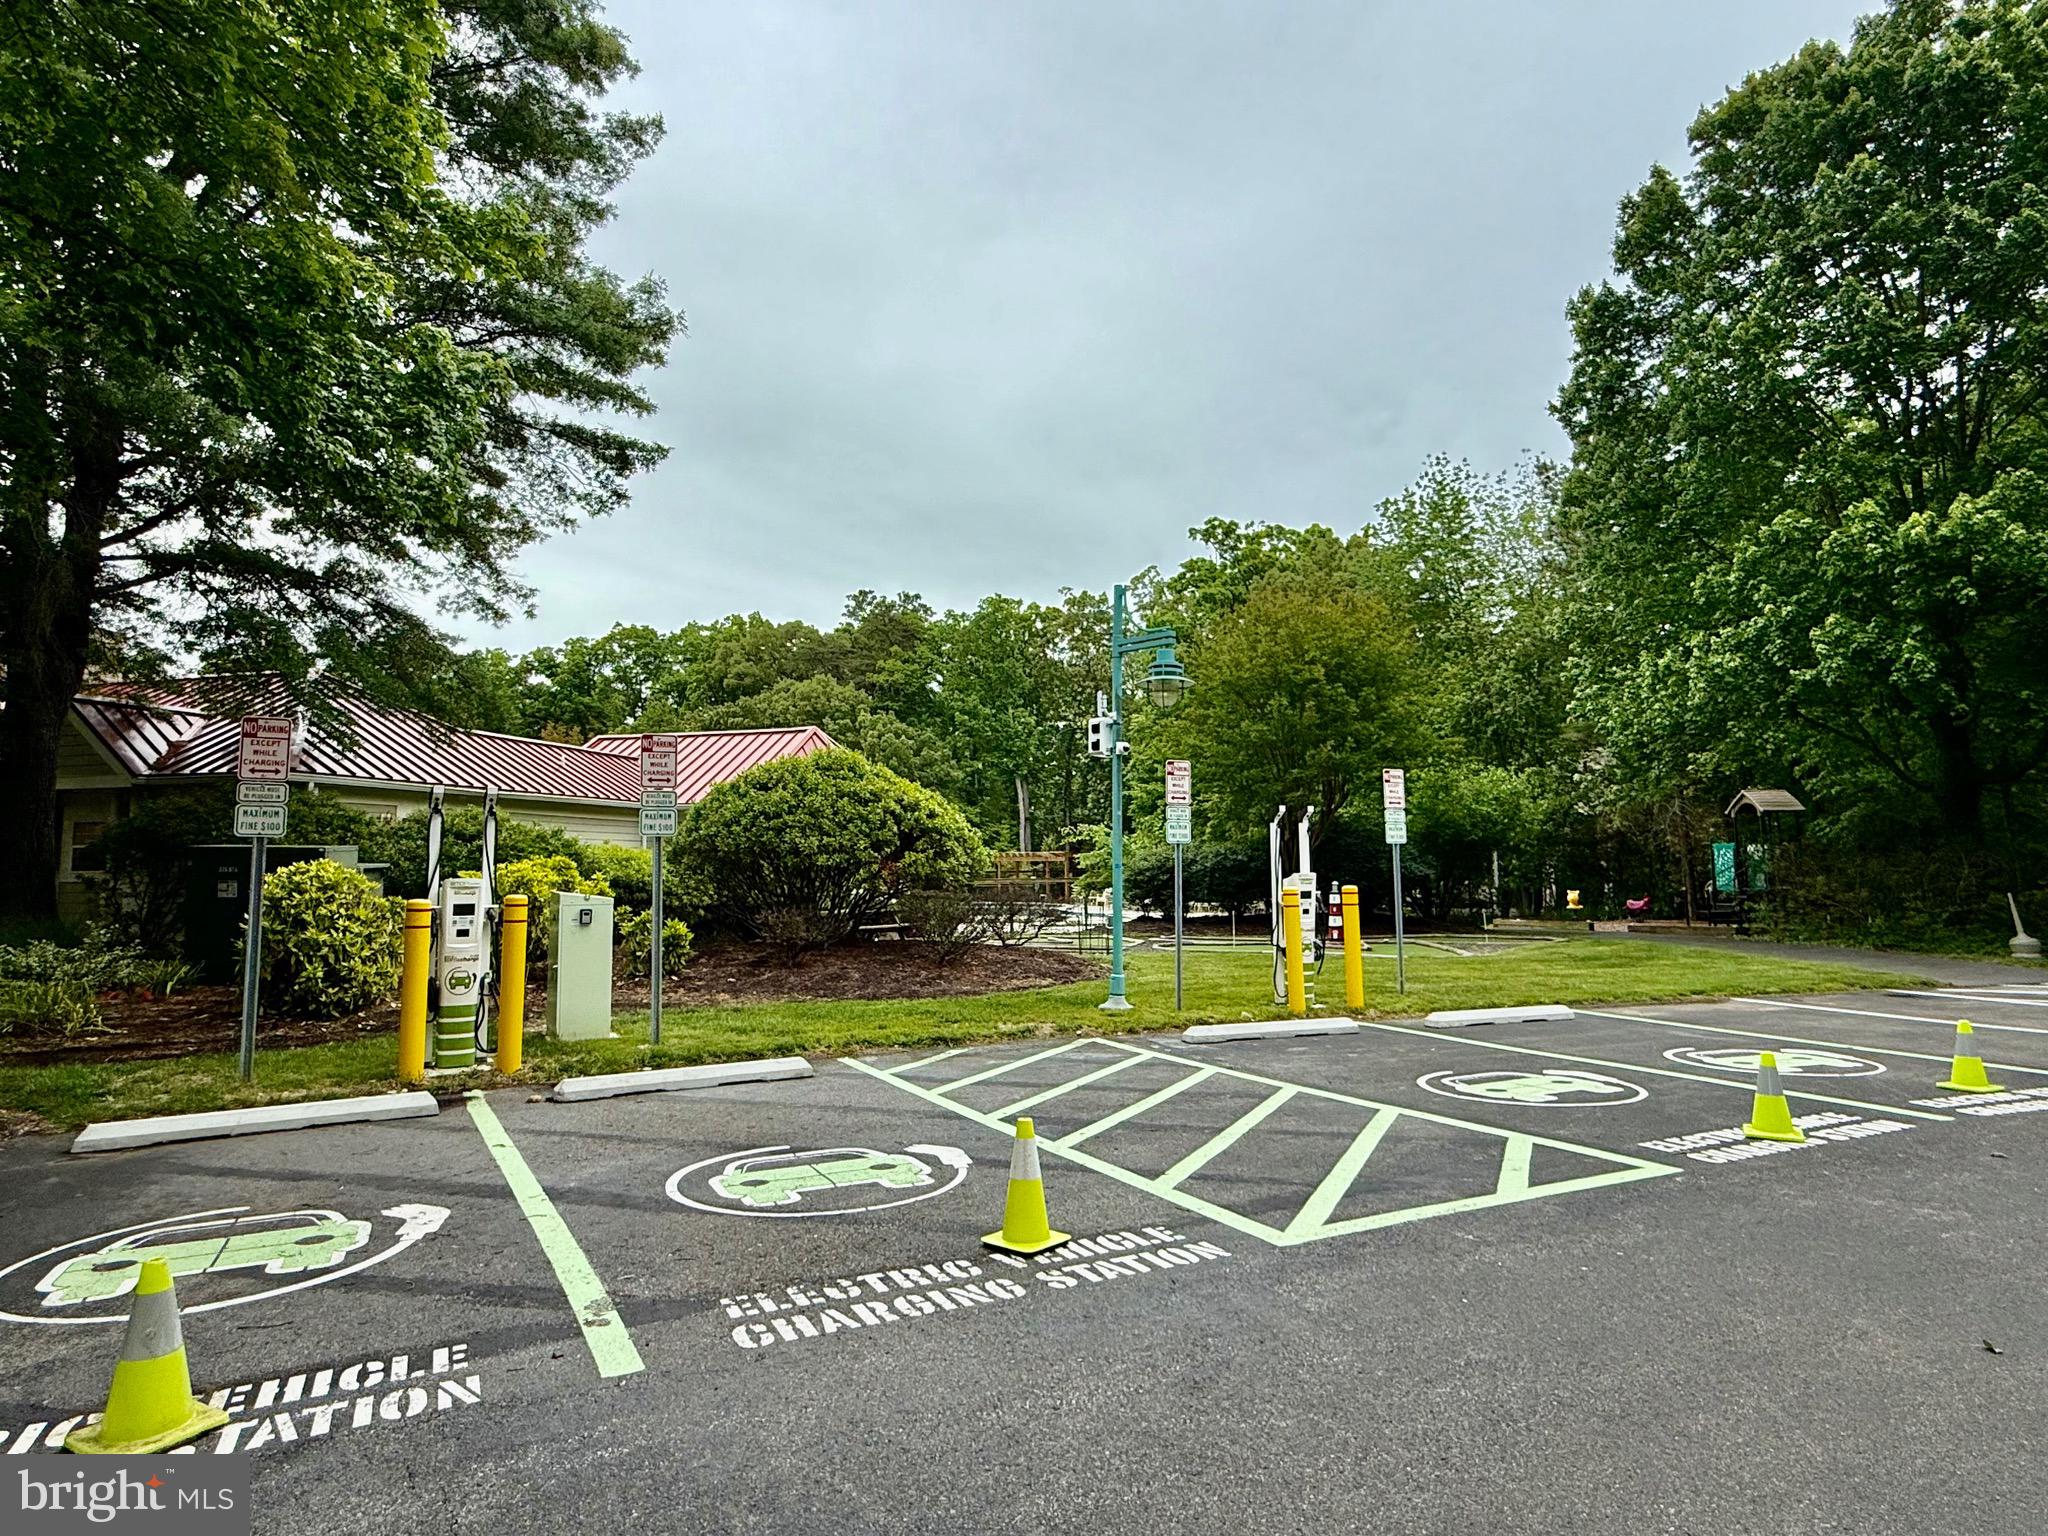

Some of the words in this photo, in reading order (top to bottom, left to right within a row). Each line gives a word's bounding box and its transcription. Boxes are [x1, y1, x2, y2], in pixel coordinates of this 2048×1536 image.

[243, 721, 258, 734] NO
[258, 724, 289, 735] PARKING
[250, 739, 281, 747] EXCEPT
[642, 738, 653, 749] NO
[653, 740, 676, 748] PARKING
[243, 758, 286, 767] CHARGING
[643, 769, 675, 777] CHARGING
[242, 809, 280, 818] MAXIMUM
[240, 821, 257, 831] FINE
[260, 821, 281, 831] $100
[643, 823, 657, 831] FINE
[658, 823, 673, 832] $100
[720, 1259, 983, 1319] ELECTRIC
[732, 1278, 1027, 1350] CHARGING
[1036, 1240, 1233, 1289] STATION
[193, 1343, 470, 1415] EHICLE
[168, 1375, 483, 1454] TATION
